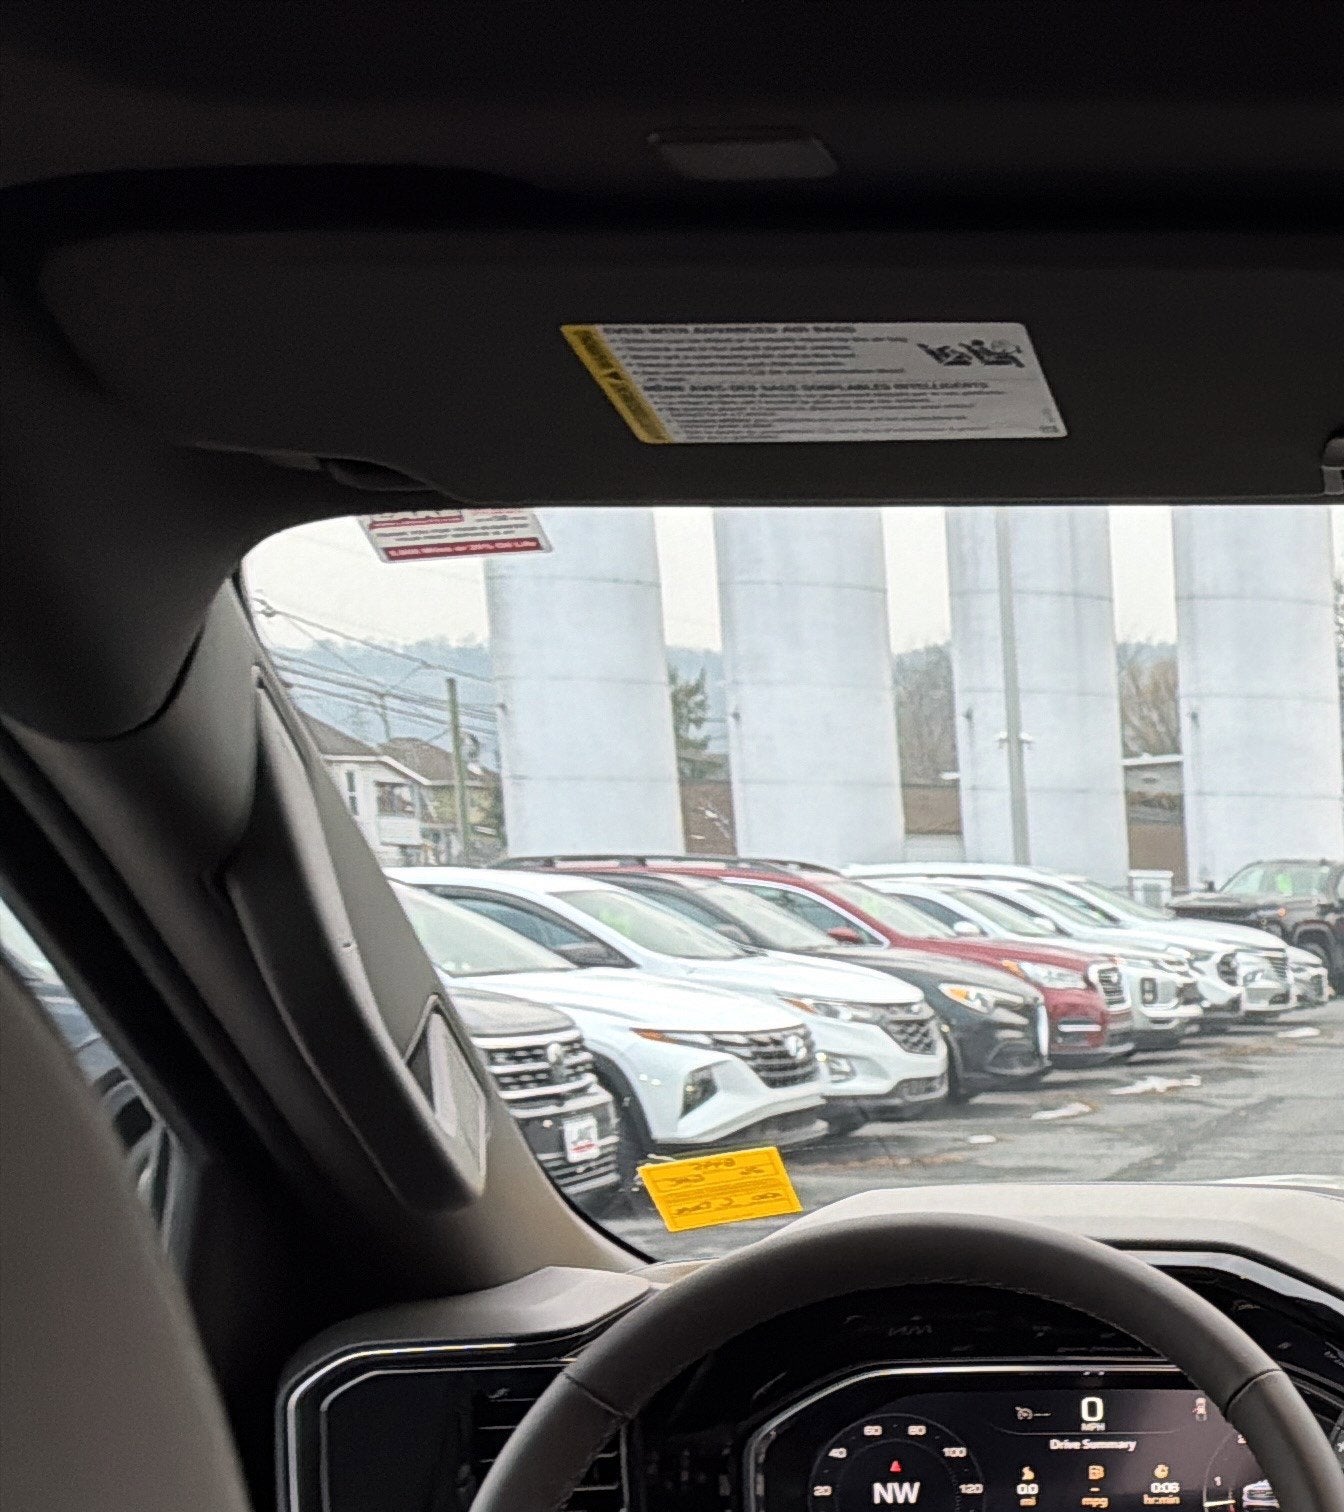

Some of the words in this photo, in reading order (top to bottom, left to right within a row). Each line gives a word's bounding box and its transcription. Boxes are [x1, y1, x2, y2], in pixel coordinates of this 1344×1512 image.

[1080, 1396, 1105, 1422] 0
[1049, 1439, 1081, 1451] Drive
[1082, 1439, 1138, 1452] Summary
[942, 1446, 967, 1458] 100
[813, 1485, 832, 1497] 20
[872, 1481, 921, 1505] NW
[958, 1483, 984, 1495] 120
